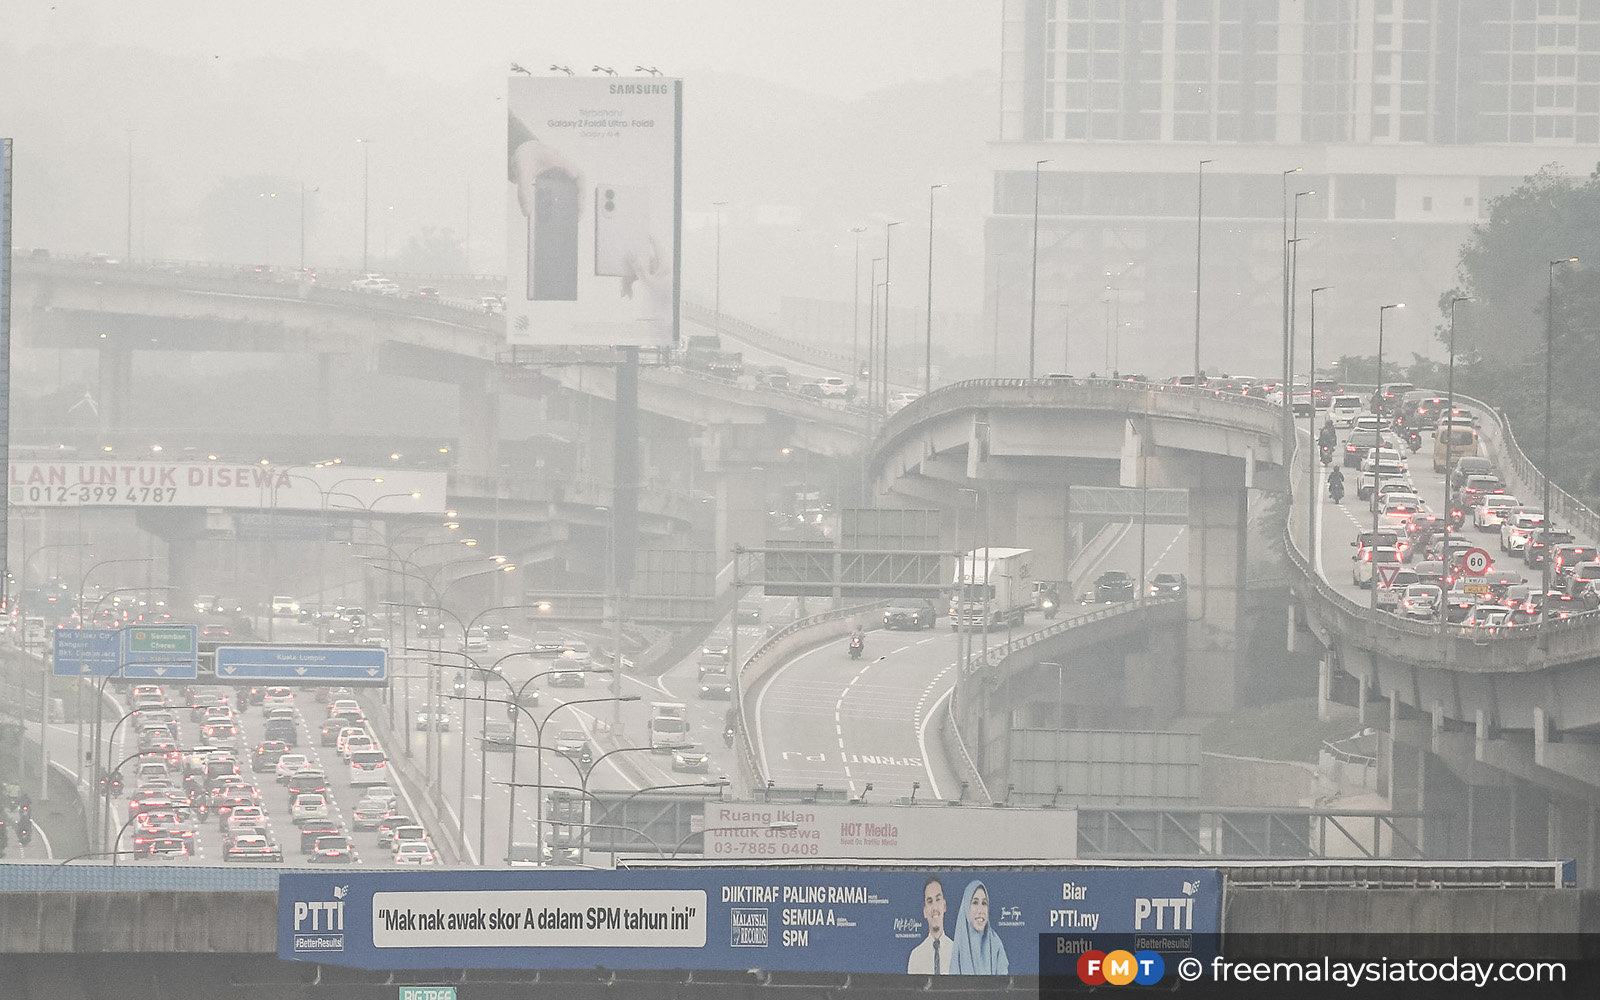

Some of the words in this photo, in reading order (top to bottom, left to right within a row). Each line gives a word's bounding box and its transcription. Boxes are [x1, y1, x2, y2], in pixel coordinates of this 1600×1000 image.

[609, 84, 668, 94] SAMSUNG
[547, 120, 576, 129] Galaxy
[79, 466, 177, 486] UNTUK
[188, 467, 292, 488] DISEWA
[30, 487, 117, 502] 012-399
[126, 487, 178, 503] 4787
[1470, 558, 1483, 567] 60
[300, 654, 326, 662] Lumpur
[850, 755, 923, 767] SPRINT
[720, 810, 771, 824] Ruang
[777, 810, 815, 823] Iklan
[714, 828, 759, 839] untuk
[764, 825, 820, 840] disewa
[840, 823, 861, 837] HOT
[865, 823, 898, 838] Media
[714, 842, 776, 855] 03-7885
[781, 843, 819, 856] 0408
[722, 886, 779, 903] DIIKTIRAF
[783, 886, 826, 903] PALING
[828, 887, 867, 904] RAMAI
[1062, 882, 1087, 900] Biar
[294, 901, 344, 931] PTTI
[418, 909, 445, 931] nak
[448, 909, 486, 931] awak
[489, 908, 521, 930] skor
[523, 908, 535, 930] A
[537, 908, 583, 930] dalam
[586, 908, 621, 930] SPM
[624, 908, 668, 930] tahun
[733, 914, 767, 926] MALAYSIA
[782, 908, 823, 926] SEMUA
[826, 909, 835, 926] A
[1050, 910, 1099, 931] PTTI.my
[1135, 898, 1193, 930] PTTI
[295, 937, 343, 949] #BetterResults!
[741, 928, 767, 944] RECORDS
[782, 930, 808, 947] SPM
[1136, 938, 1191, 949] #BetterResults!
[1057, 937, 1092, 954] Bantu
